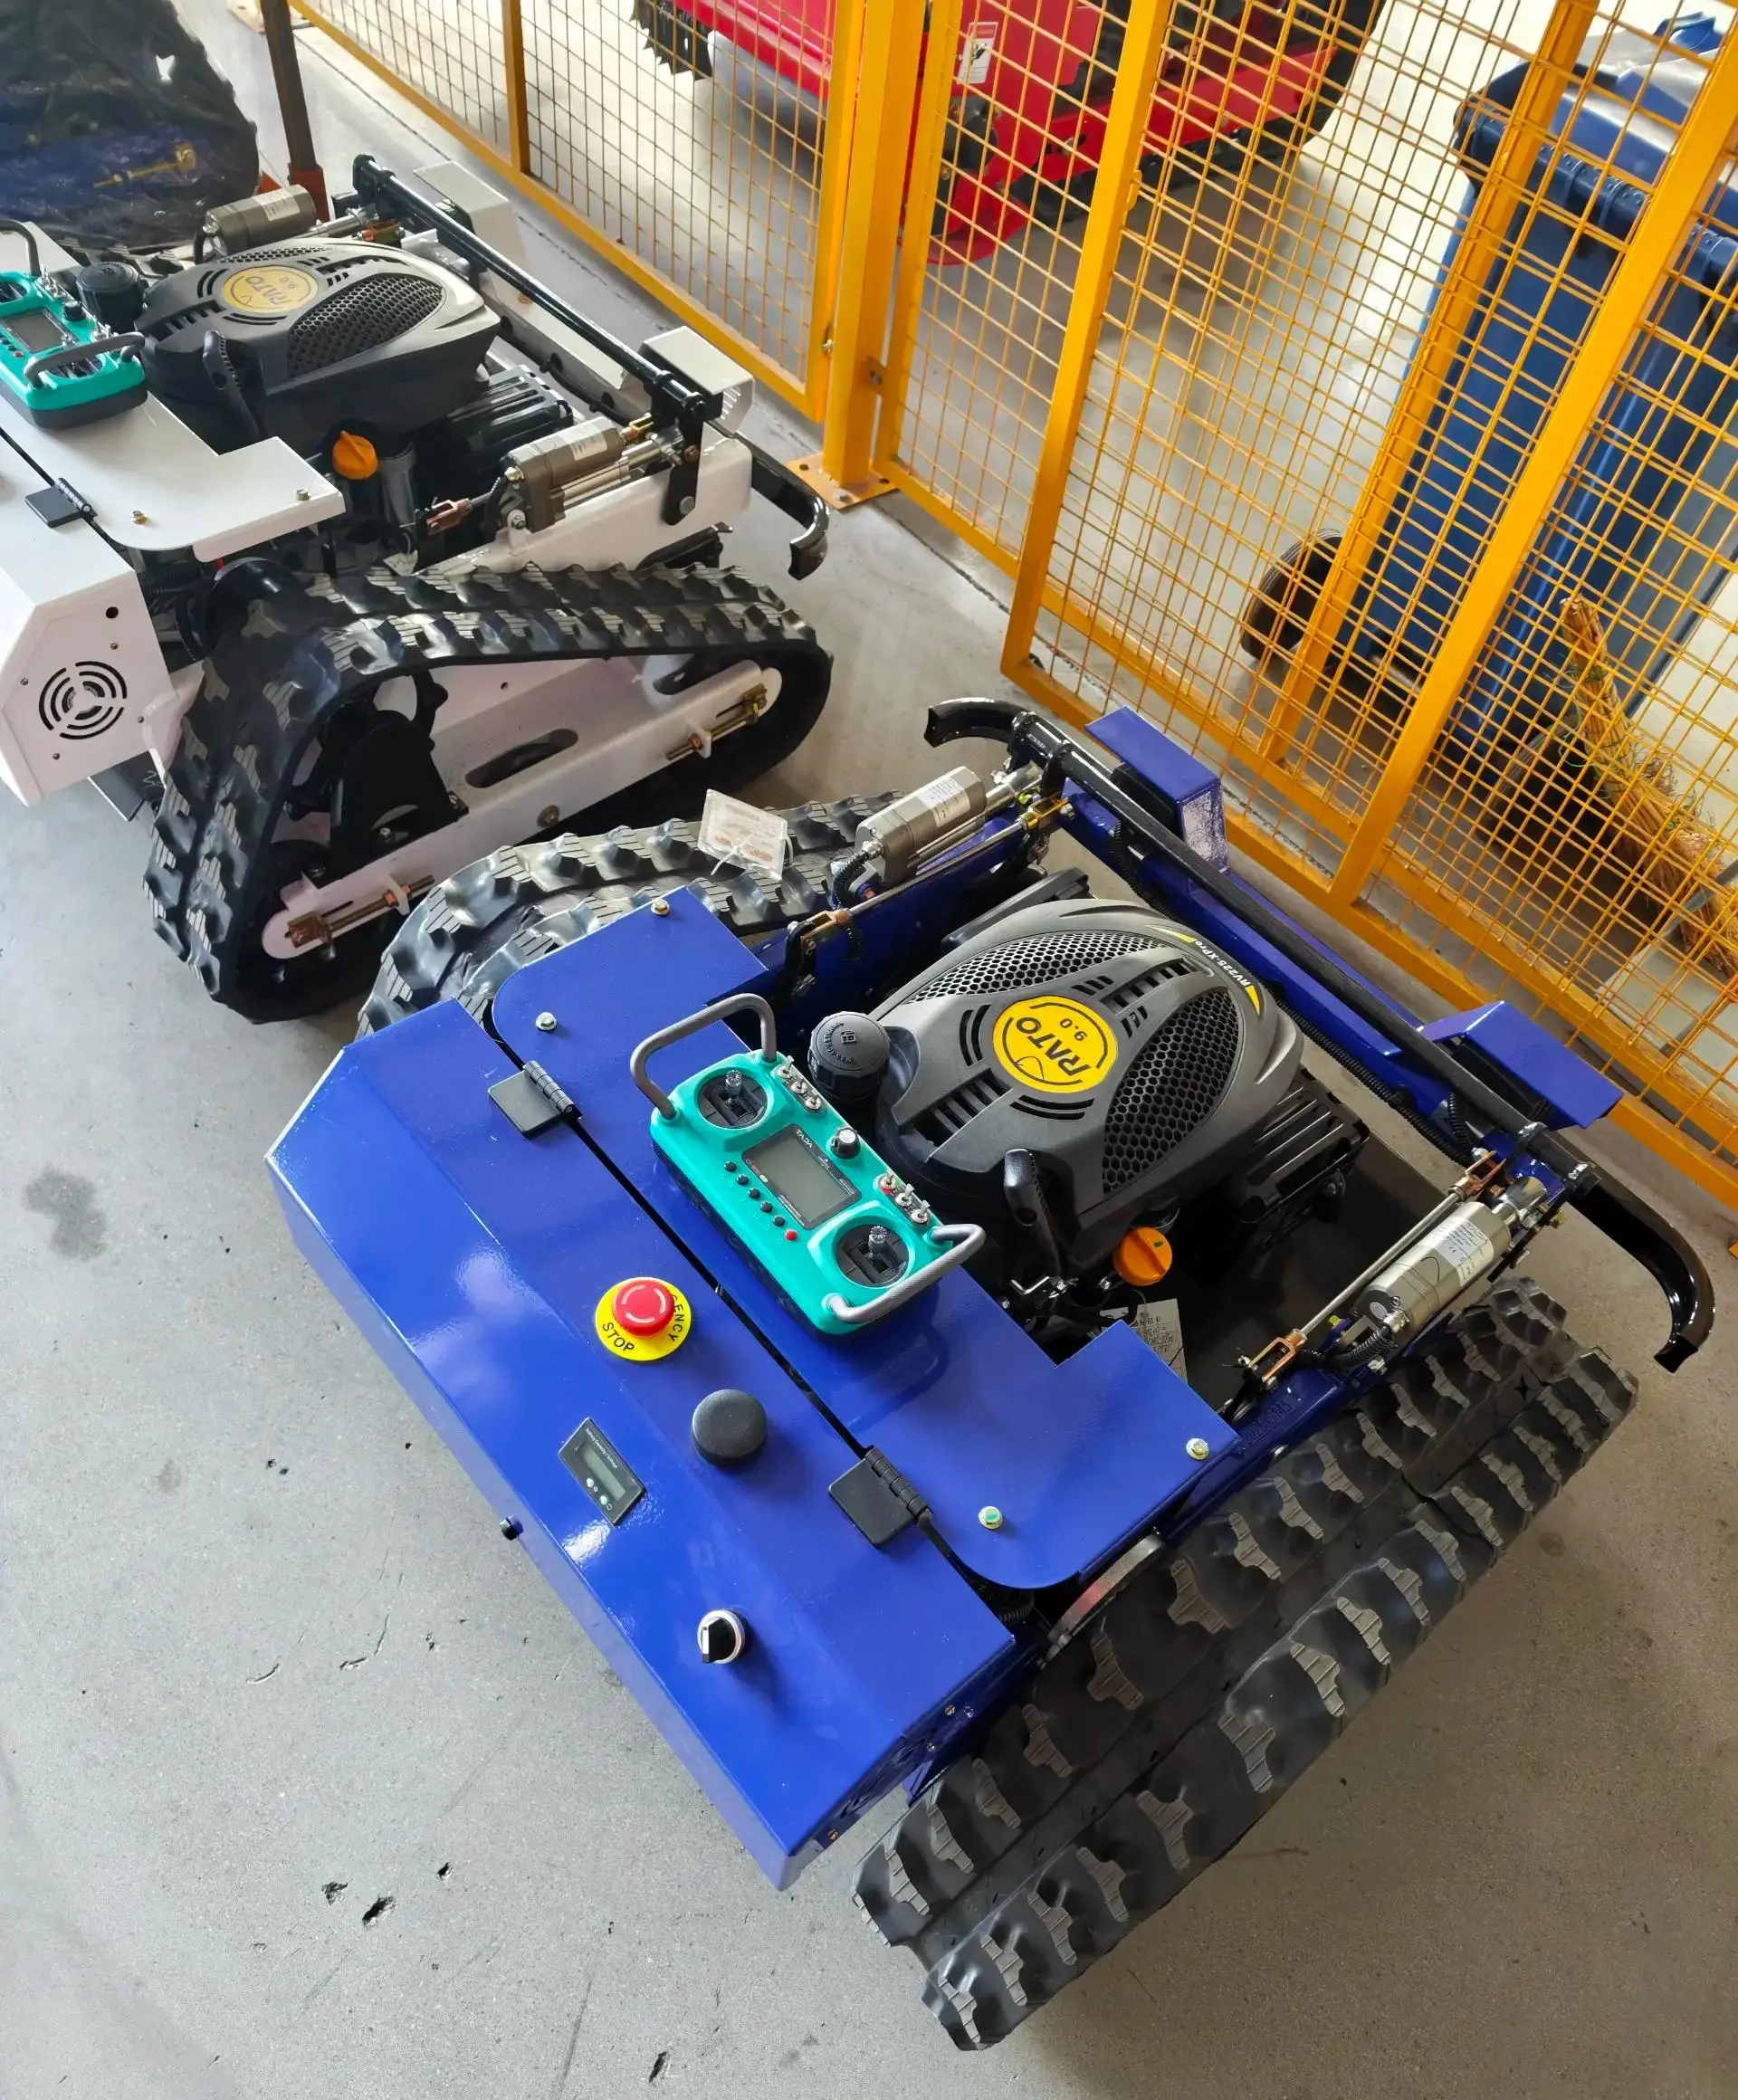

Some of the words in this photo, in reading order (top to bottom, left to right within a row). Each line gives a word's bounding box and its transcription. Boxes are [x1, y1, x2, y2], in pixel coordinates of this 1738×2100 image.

[245, 276, 292, 305] RATO
[1195, 940, 1251, 987] RV225-XPro
[1059, 1018, 1087, 1041] 9.0
[1016, 1017, 1092, 1076] RATO
[602, 1322, 635, 1351] STOP
